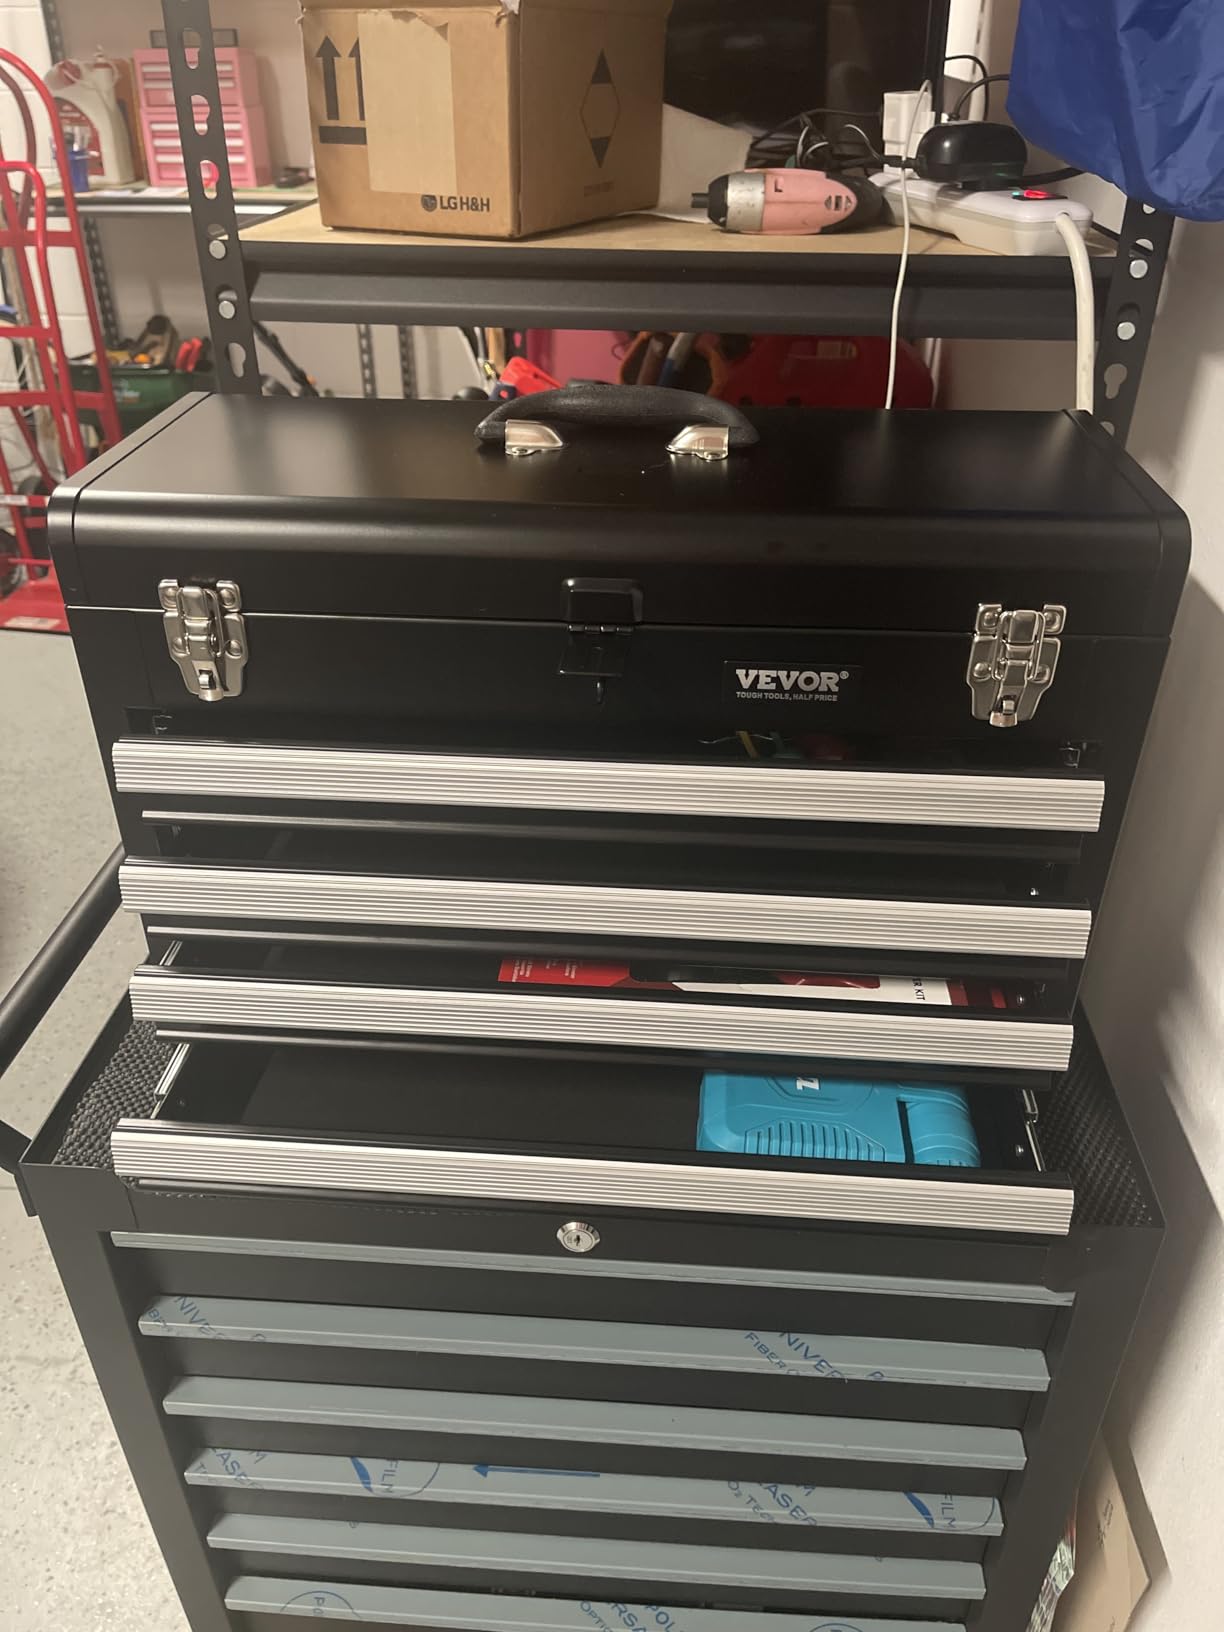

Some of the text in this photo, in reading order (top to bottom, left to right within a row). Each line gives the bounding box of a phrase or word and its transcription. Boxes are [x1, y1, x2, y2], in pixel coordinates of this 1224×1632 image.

[439, 195, 490, 212] LG H&H
[735, 691, 838, 702] TOUGH TOOLS, HALF PRICE
[914, 988, 926, 1001] KIT
[744, 1332, 787, 1370] FIBER
